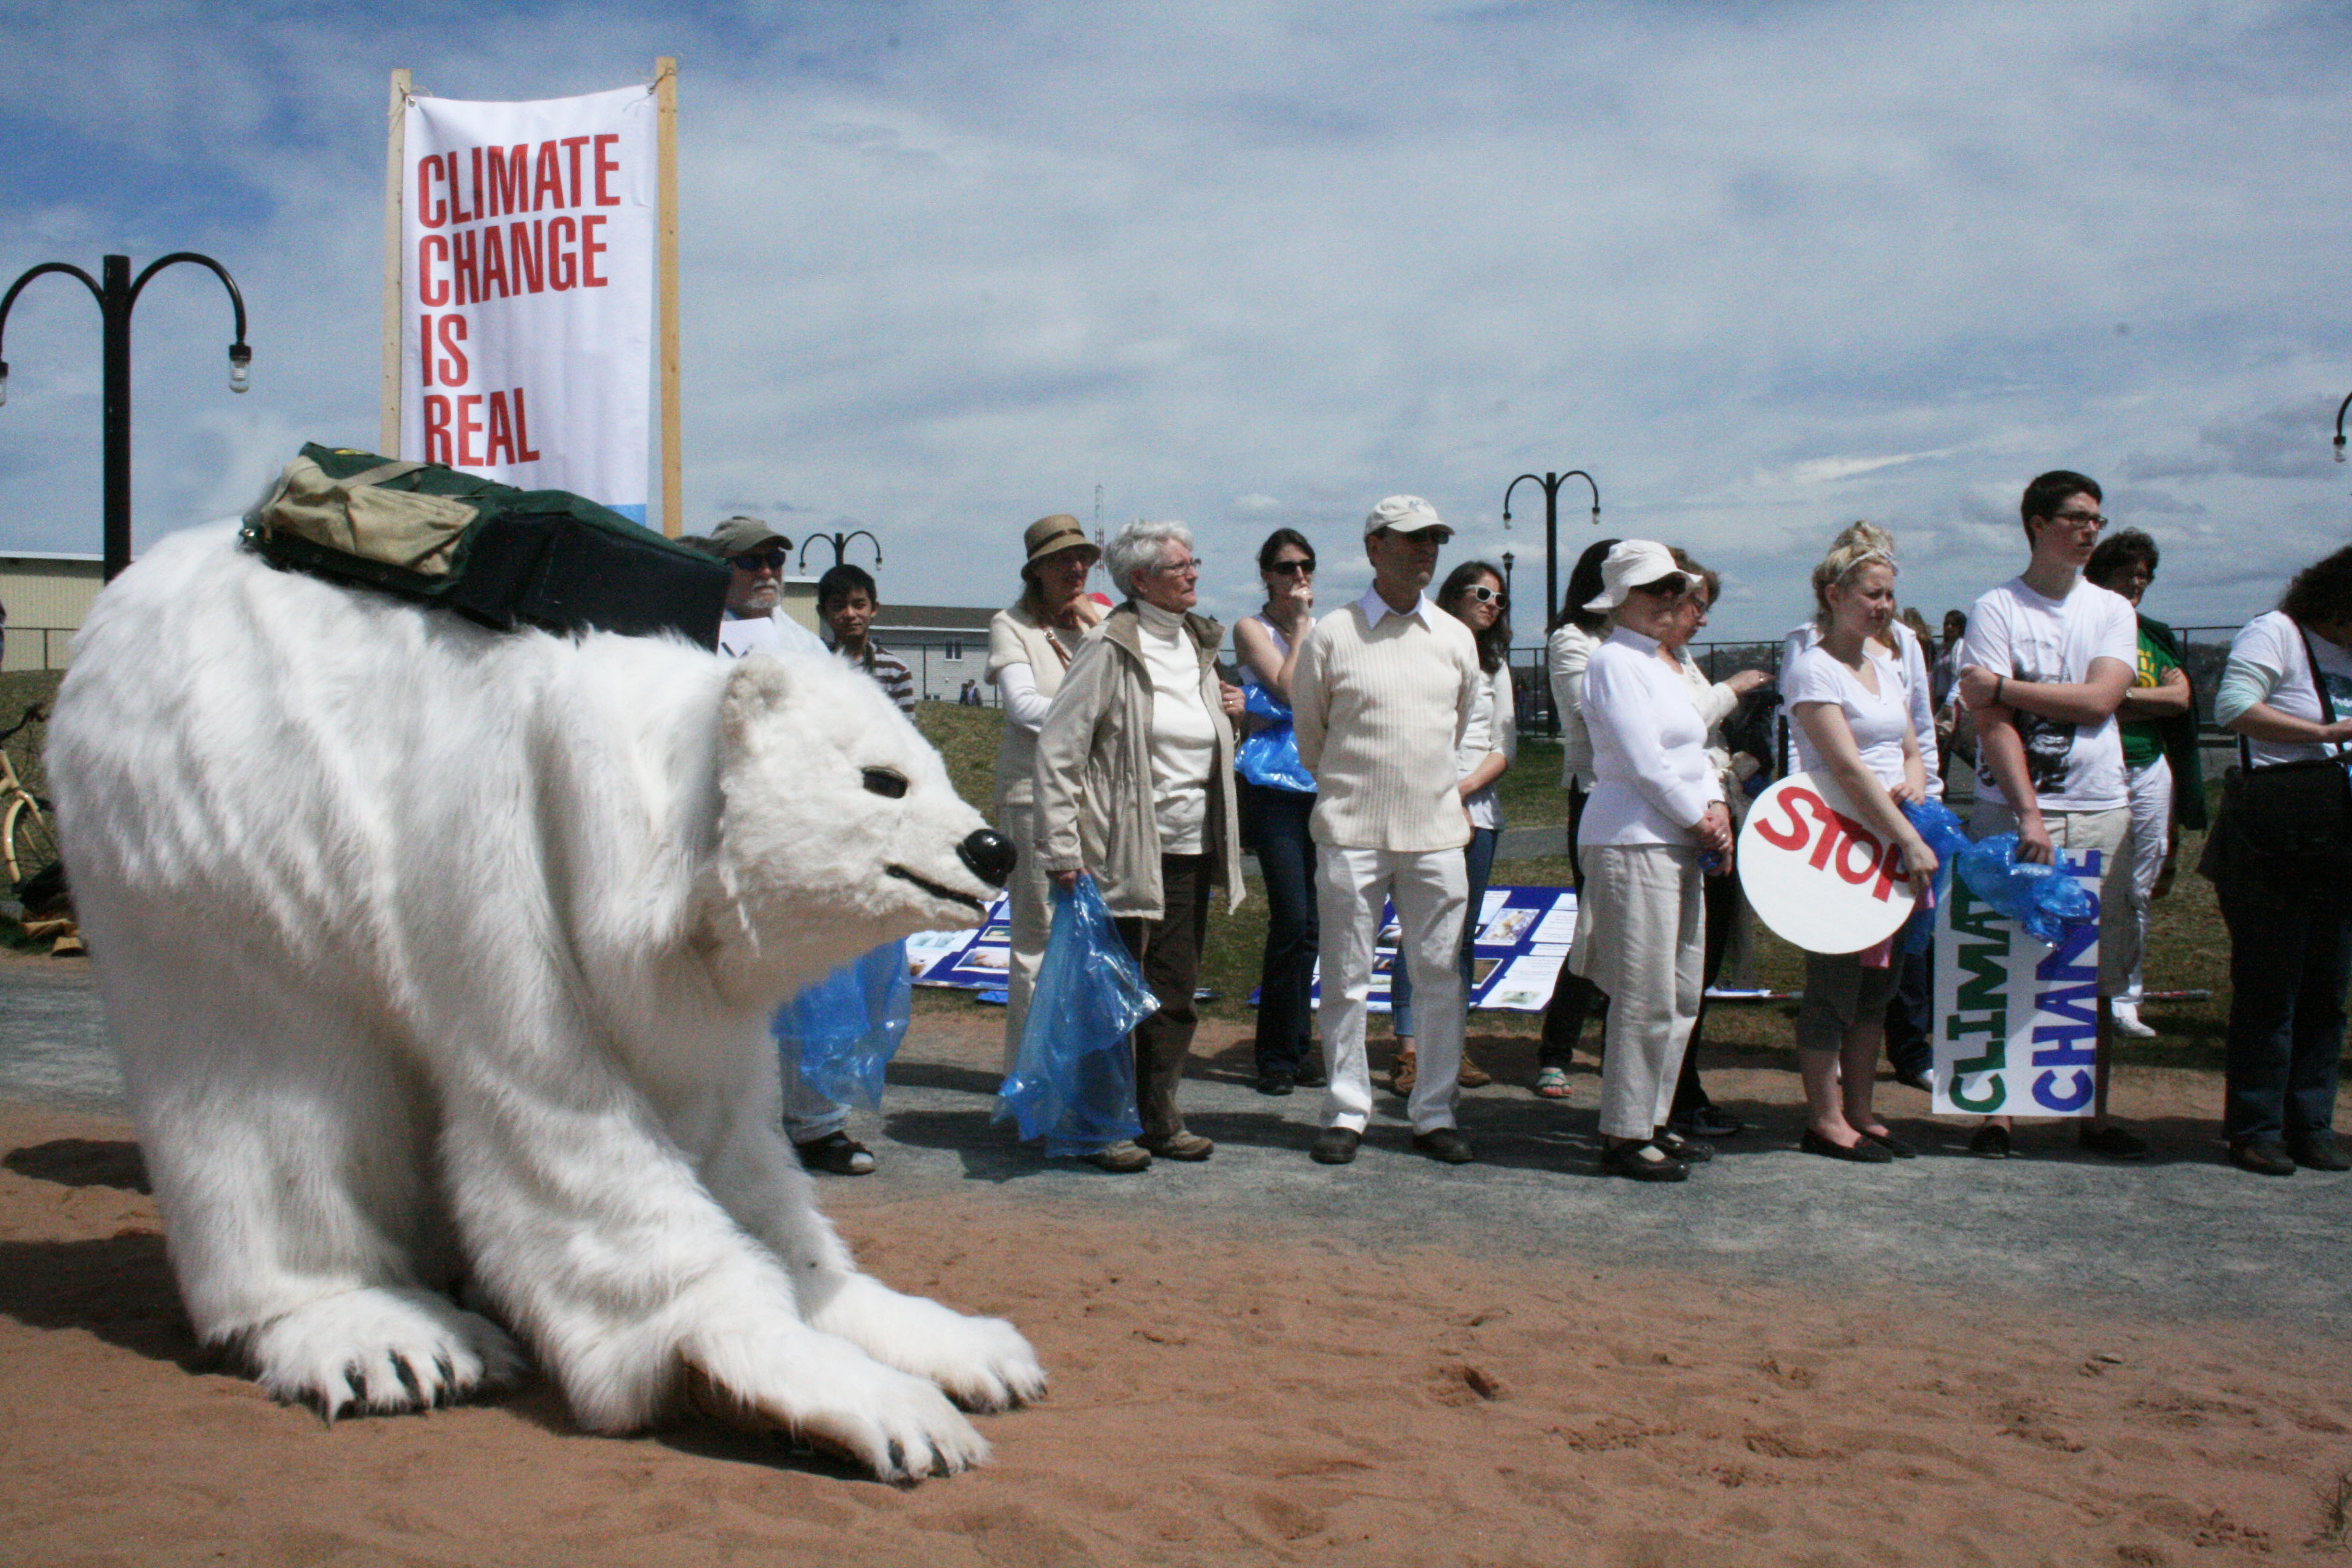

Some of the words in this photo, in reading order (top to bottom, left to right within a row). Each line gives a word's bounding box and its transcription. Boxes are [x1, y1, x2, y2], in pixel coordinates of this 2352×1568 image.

[418, 134, 620, 229] CLIMATE
[419, 215, 609, 307] CHANGE
[420, 314, 468, 388] IS
[424, 388, 540, 467] REAL
[1754, 786, 1910, 903] STOP
[1947, 852, 2011, 1113] CLIMAT
